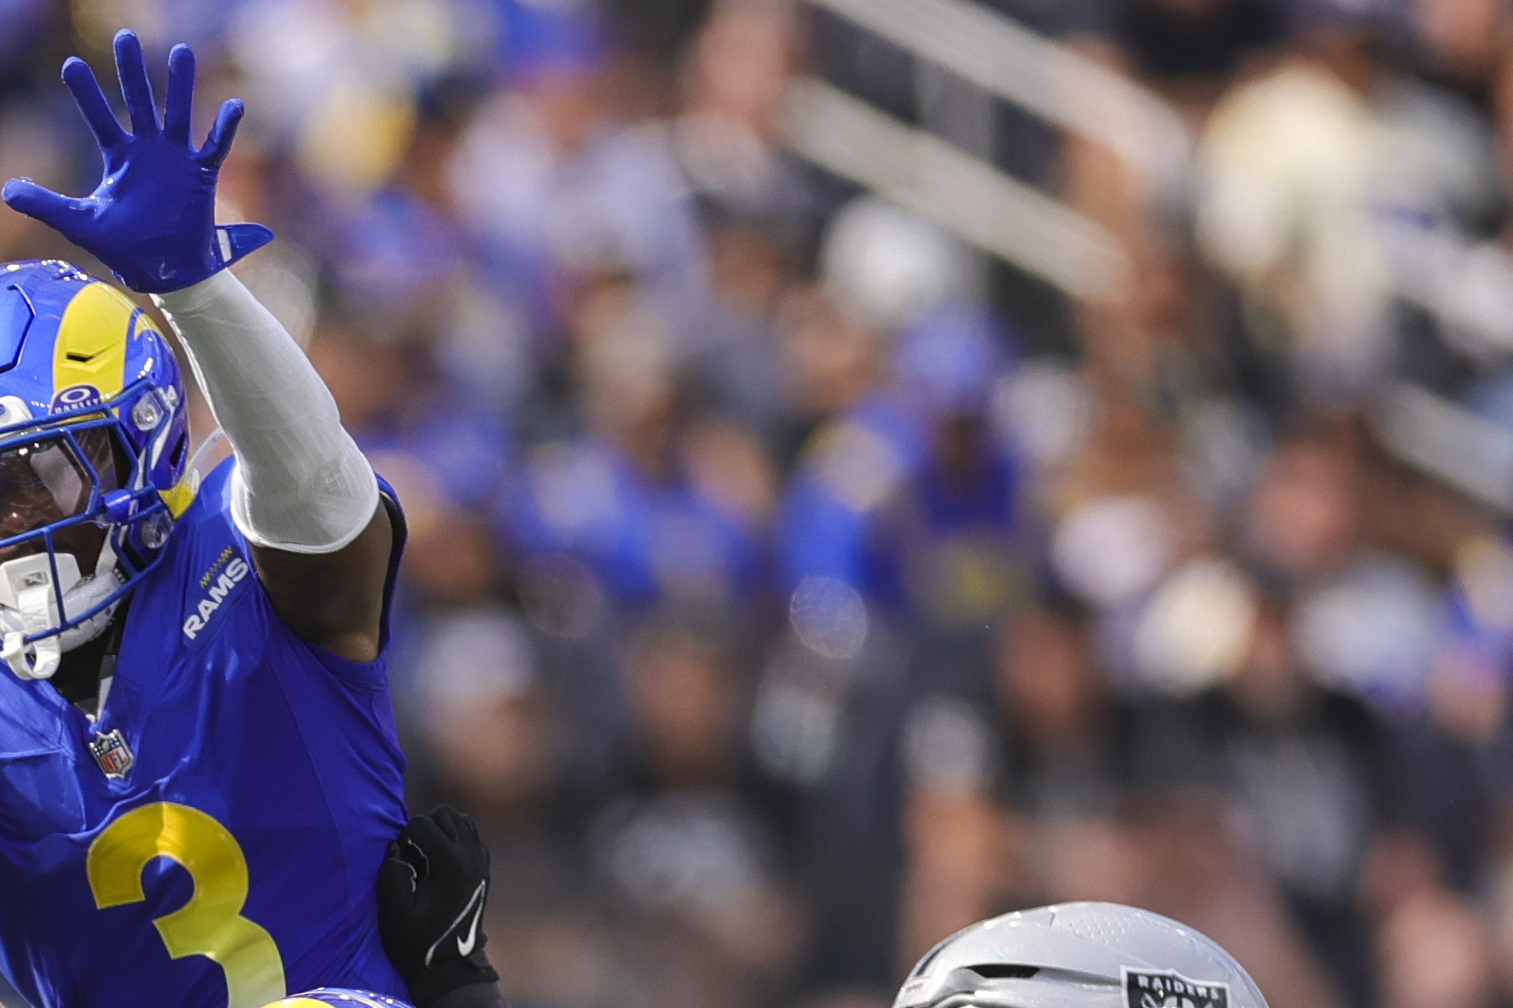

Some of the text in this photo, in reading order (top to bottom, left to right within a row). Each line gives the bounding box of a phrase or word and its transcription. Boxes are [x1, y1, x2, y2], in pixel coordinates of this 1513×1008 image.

[183, 558, 249, 640] RAMS
[100, 746, 129, 772] NFL
[1137, 975, 1220, 1000] RAIDERS
